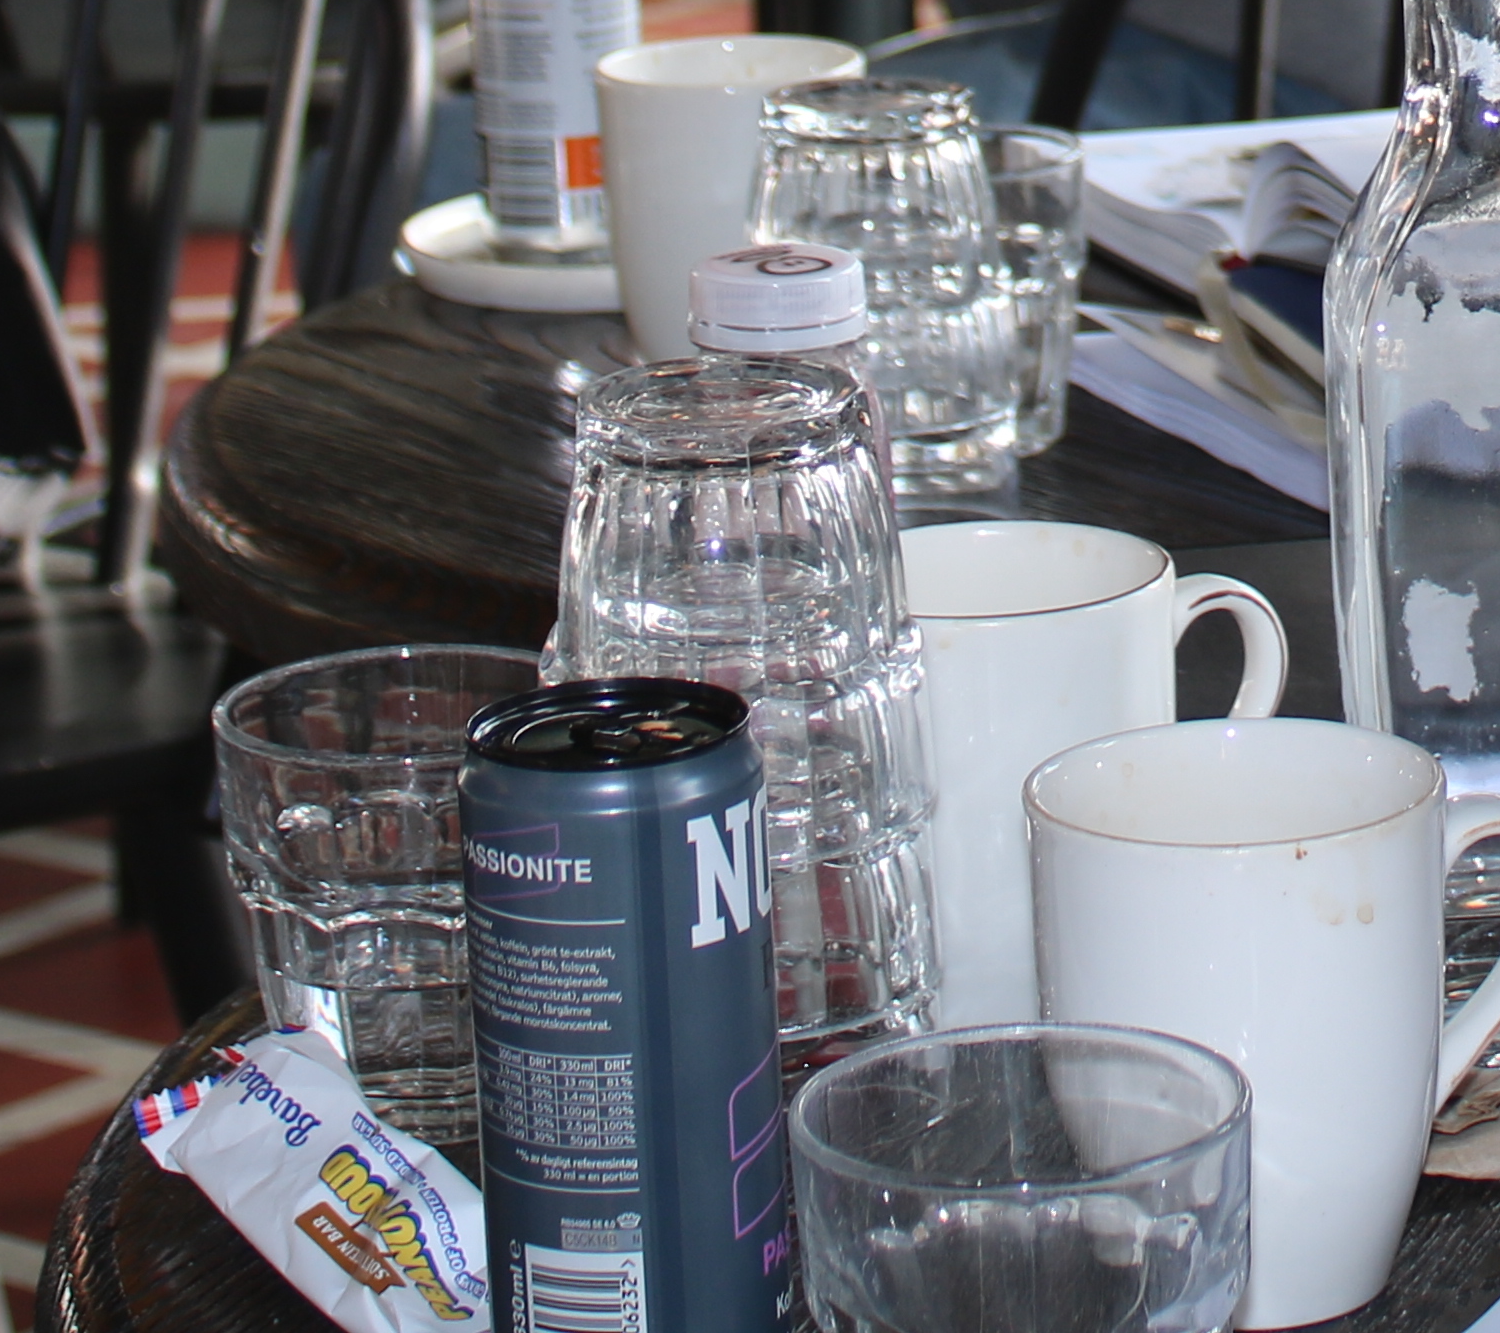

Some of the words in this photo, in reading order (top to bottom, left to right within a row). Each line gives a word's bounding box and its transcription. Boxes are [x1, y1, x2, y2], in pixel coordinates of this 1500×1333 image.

[463, 834, 592, 883] PASSIONITE
[559, 946, 616, 960] te-extrakt,
[541, 960, 559, 974] B6,
[561, 960, 599, 975] folsyra,
[582, 991, 623, 1004] aromer,
[543, 1002, 592, 1018] färgämne
[601, 1091, 634, 1102] 100%
[603, 1120, 635, 1131] 100%
[604, 1134, 636, 1146] 100%
[573, 1157, 638, 1170] referensintag
[543, 1168, 562, 1180] 330
[602, 1170, 639, 1184] portion
[312, 1215, 344, 1243] BAR
[444, 1247, 467, 1274] OF
